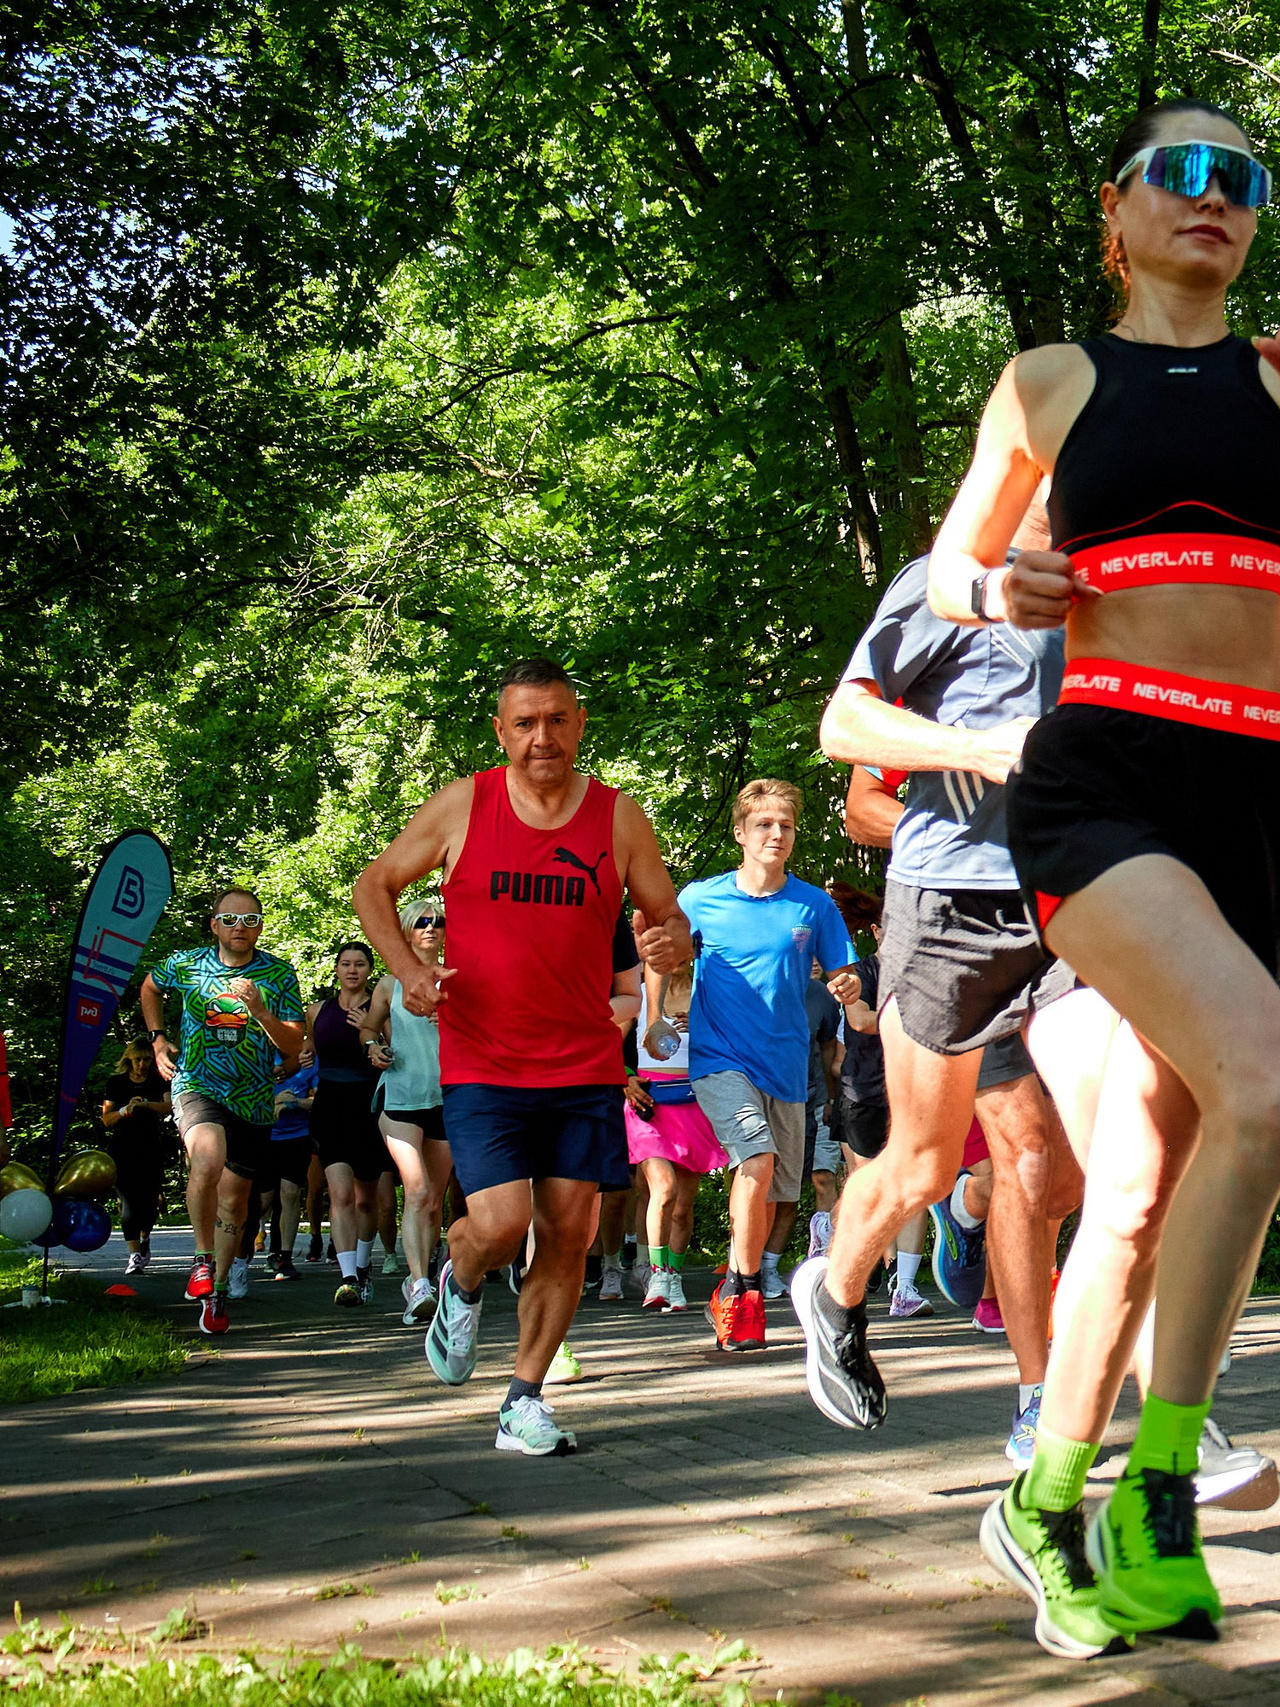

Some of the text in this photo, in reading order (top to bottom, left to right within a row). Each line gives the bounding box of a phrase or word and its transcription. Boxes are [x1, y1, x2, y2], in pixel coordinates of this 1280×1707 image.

[1101, 551, 1214, 576] NEVERLATE
[1133, 682, 1233, 716] NEVERLATE
[490, 871, 585, 907] PUMA
